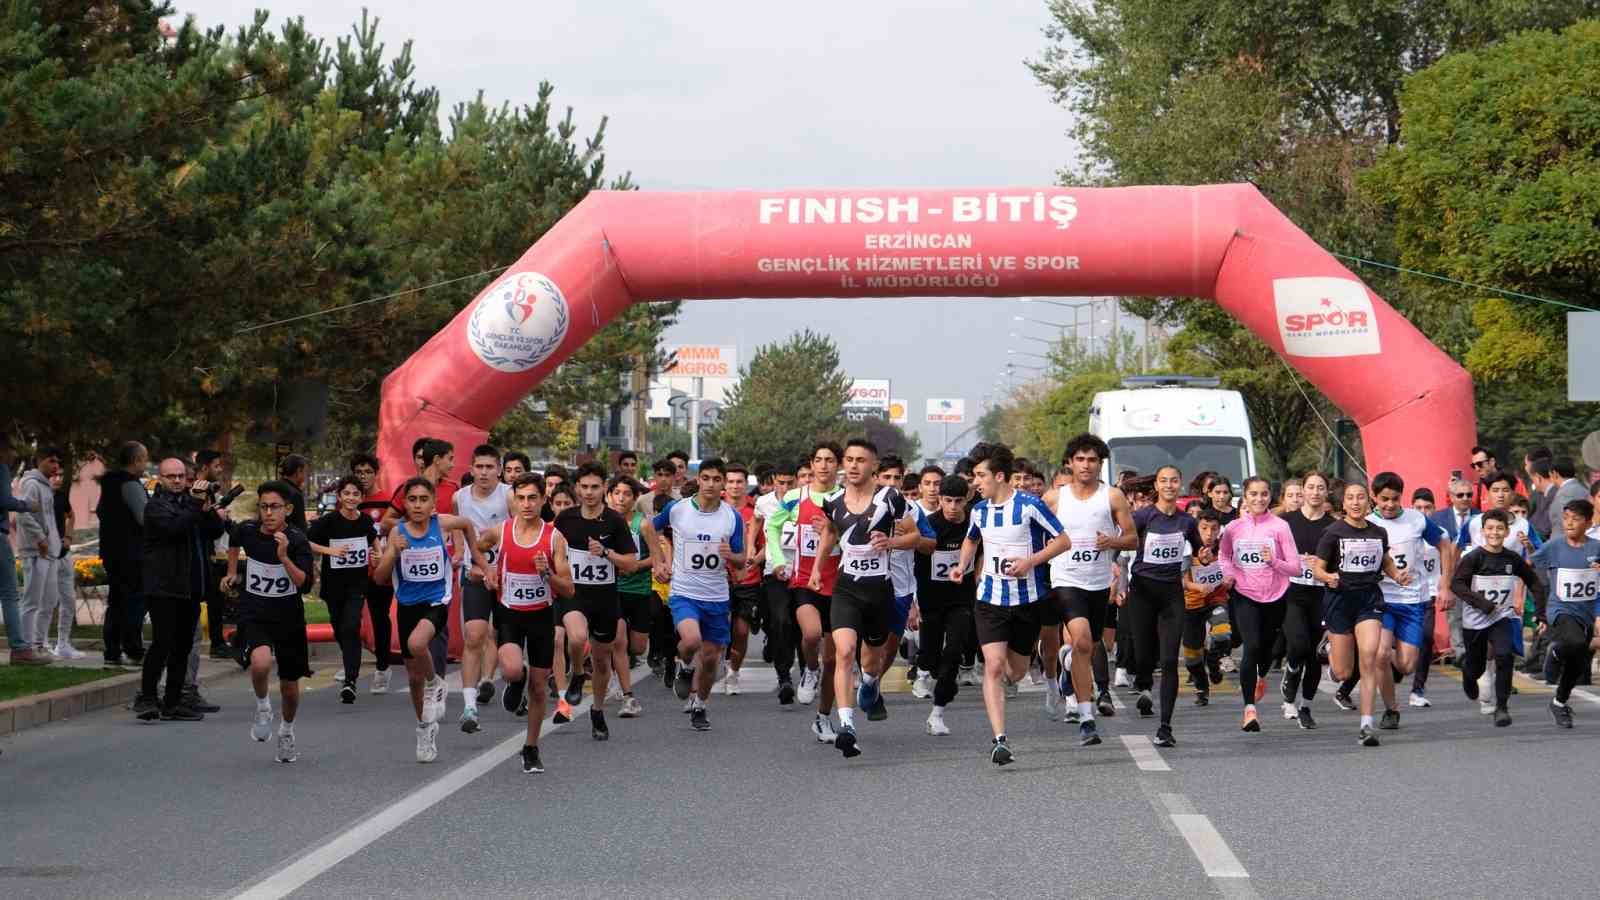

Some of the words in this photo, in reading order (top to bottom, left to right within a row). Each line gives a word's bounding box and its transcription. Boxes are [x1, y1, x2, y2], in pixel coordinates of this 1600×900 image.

[759, 197, 919, 225] FINISH
[952, 192, 1079, 230] BİTİŞ
[864, 230, 972, 249] ERZİNCAN
[757, 254, 850, 275] GENÇLİK
[856, 253, 982, 271] HİZMETLERİ
[989, 256, 1017, 270] VE
[1023, 256, 1080, 270] SPOR
[840, 273, 860, 288] İL
[866, 273, 999, 288] MÜDÜRLÜĞÜ
[1286, 311, 1368, 332] SPOR
[1072, 550, 1101, 563] 467
[1151, 548, 1178, 559] 465
[1351, 555, 1376, 567] 464
[409, 563, 439, 577] 459
[691, 554, 720, 570] 90
[850, 558, 880, 572] 455
[573, 564, 609, 581] 143
[250, 574, 290, 593] 279
[1563, 581, 1596, 598] 126
[514, 587, 546, 600] 456
